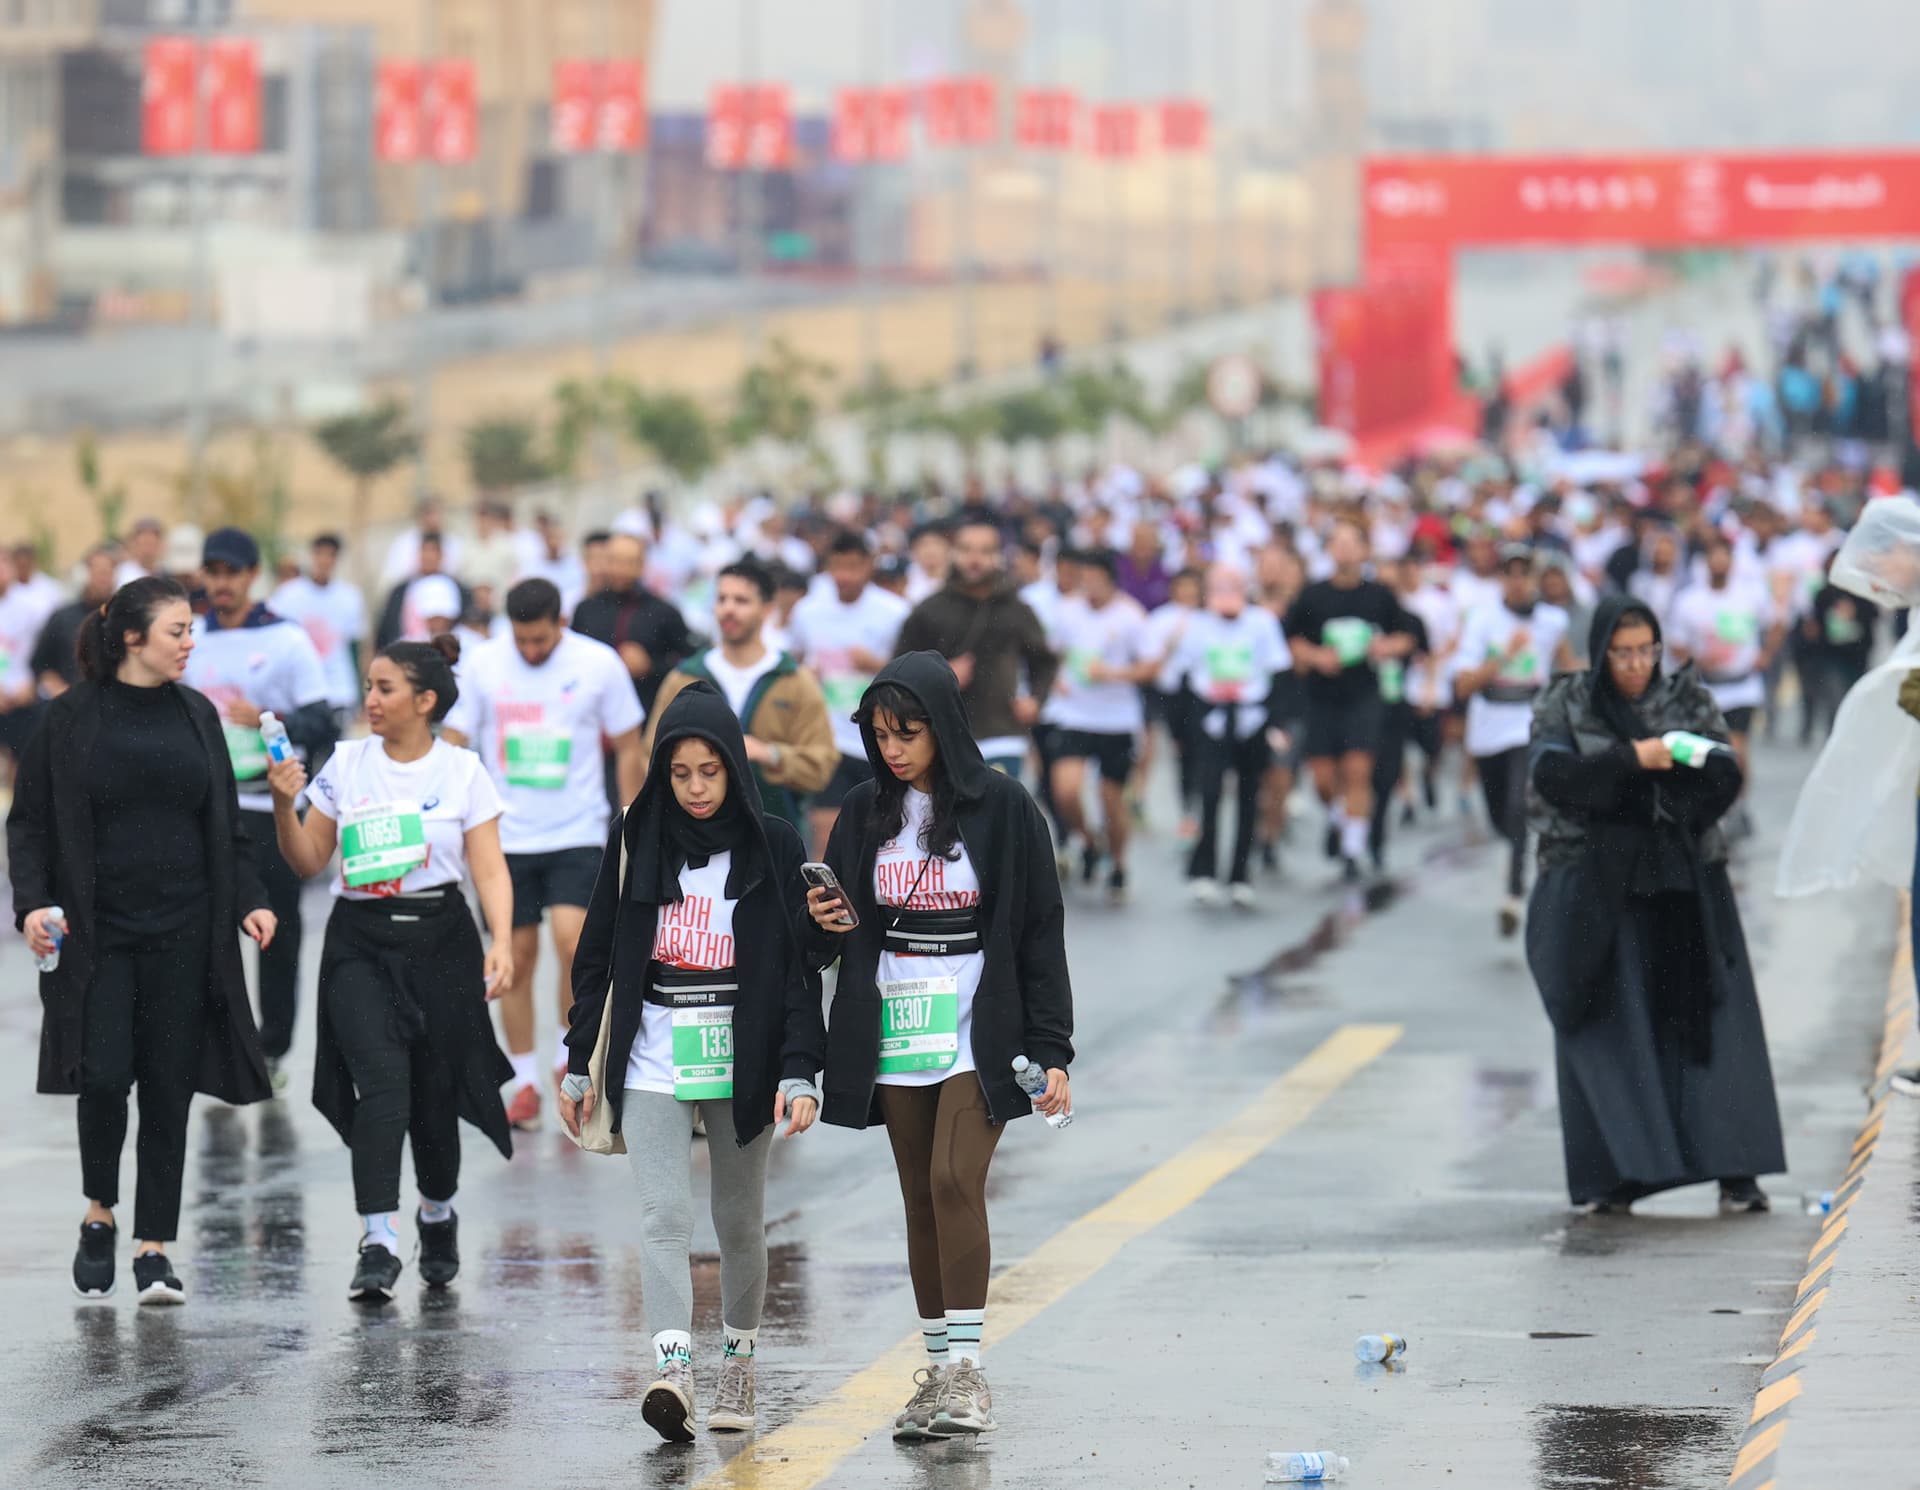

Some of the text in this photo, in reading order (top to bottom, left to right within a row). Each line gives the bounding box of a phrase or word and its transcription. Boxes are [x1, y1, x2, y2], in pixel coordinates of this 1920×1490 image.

[877, 858, 945, 897] RIYADH
[888, 996, 932, 1031] 13307
[691, 1068, 716, 1077] 10KM
